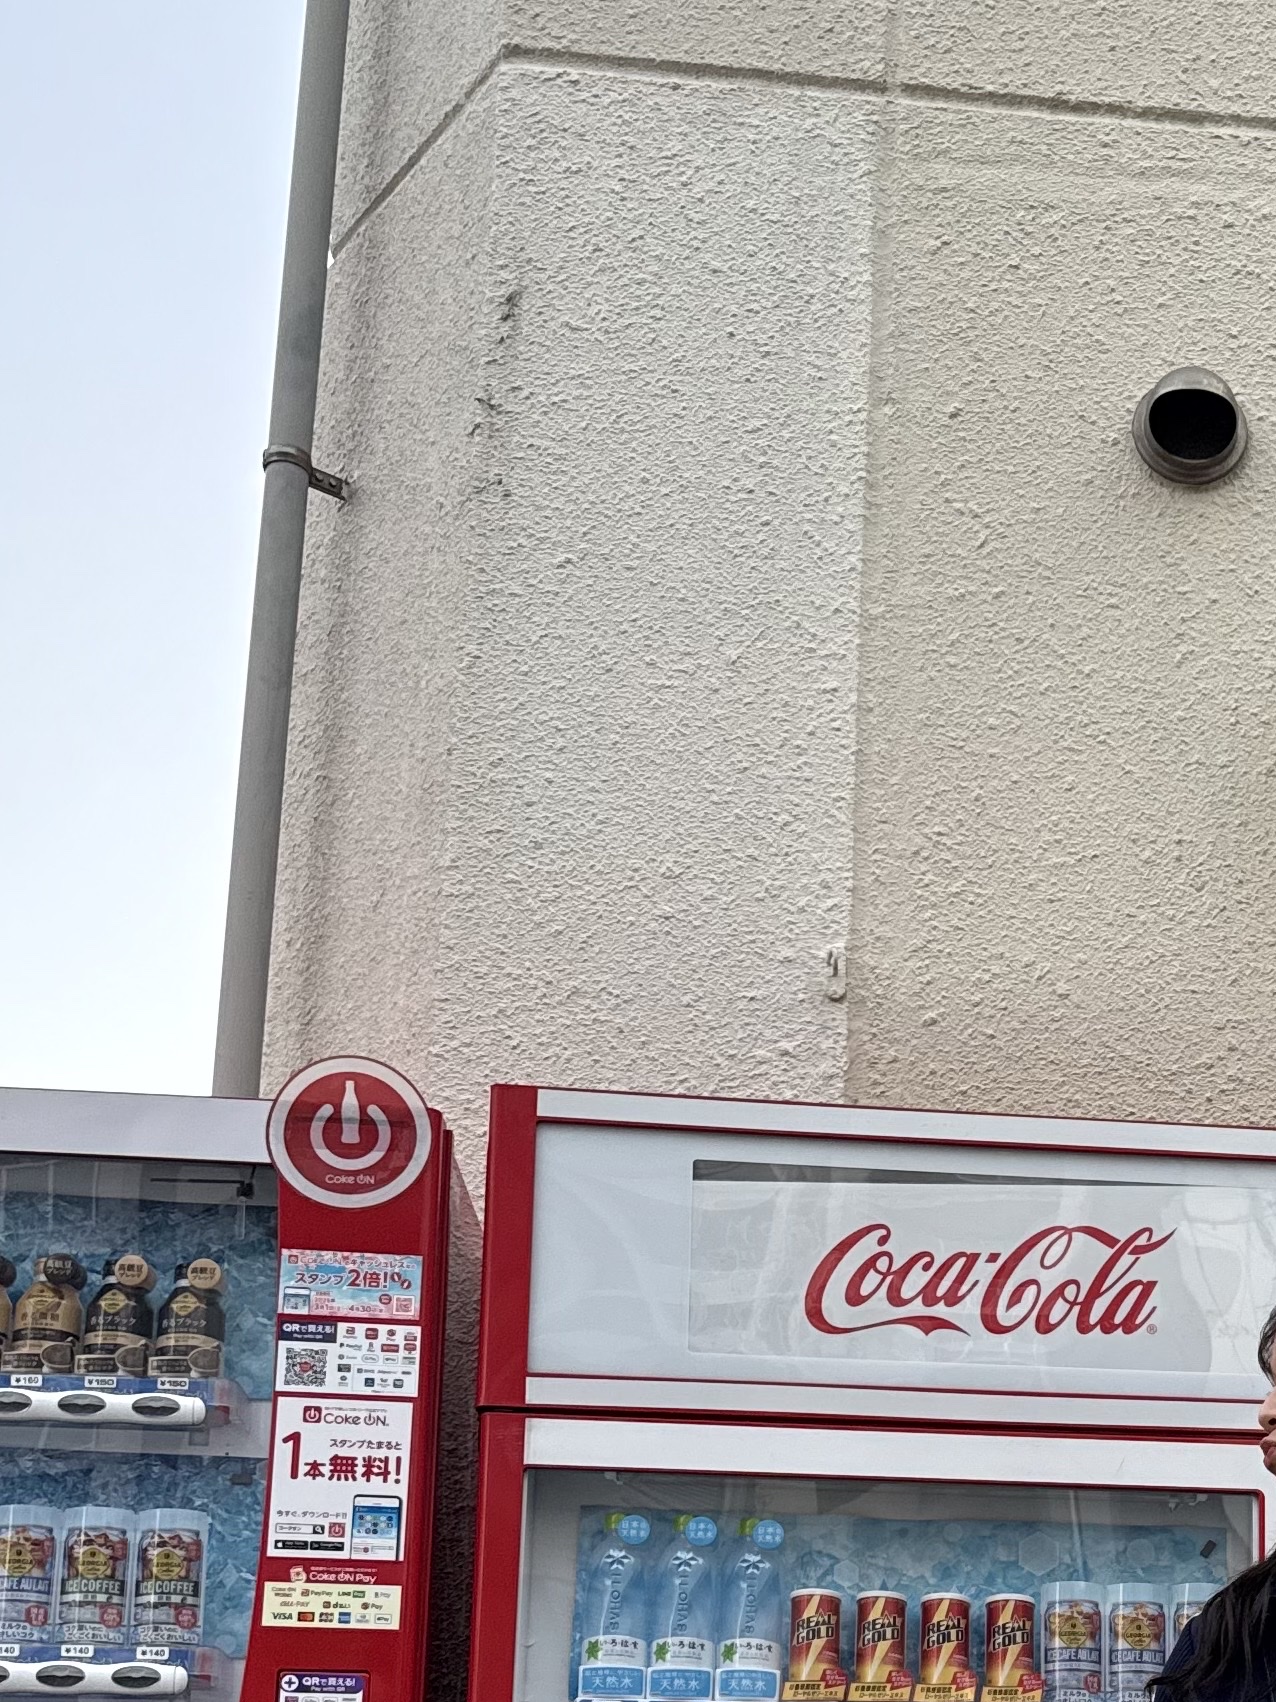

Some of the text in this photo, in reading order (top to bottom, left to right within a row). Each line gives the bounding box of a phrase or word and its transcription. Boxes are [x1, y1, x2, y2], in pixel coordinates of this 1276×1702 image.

[325, 1174, 376, 1185] Coke ON
[804, 1221, 1178, 1339] Coca-Cola
[324, 1413, 387, 1427] Coke ON
[329, 1438, 403, 1451] スタンプたまると
[309, 1571, 336, 1581] Coke
[355, 1573, 378, 1585] Pay
[65, 1579, 120, 1594] ICE COFFEE
[140, 1580, 195, 1595] ICE COFFEE
[311, 1589, 333, 1598] PayPay
[271, 1612, 293, 1620] VISA
[796, 1611, 835, 1629] REAL
[862, 1612, 900, 1631] REAL
[926, 1616, 963, 1635] REAL
[992, 1618, 1029, 1636] REAL
[66, 1632, 122, 1642] ごくごくおいしい
[141, 1633, 197, 1643] ごくごくおいしい
[796, 1627, 835, 1644] GOLD
[862, 1629, 900, 1647] GOLD
[926, 1631, 964, 1649] GOLD
[993, 1633, 1029, 1651] GOLD
[65, 1647, 89, 1655] ¥140
[140, 1649, 166, 1657] ¥140
[1122, 1651, 1140, 1661] CAFE
[592, 1677, 634, 1689] 天然水
[660, 1679, 701, 1691] 天然水
[728, 1679, 767, 1691] 天然水
